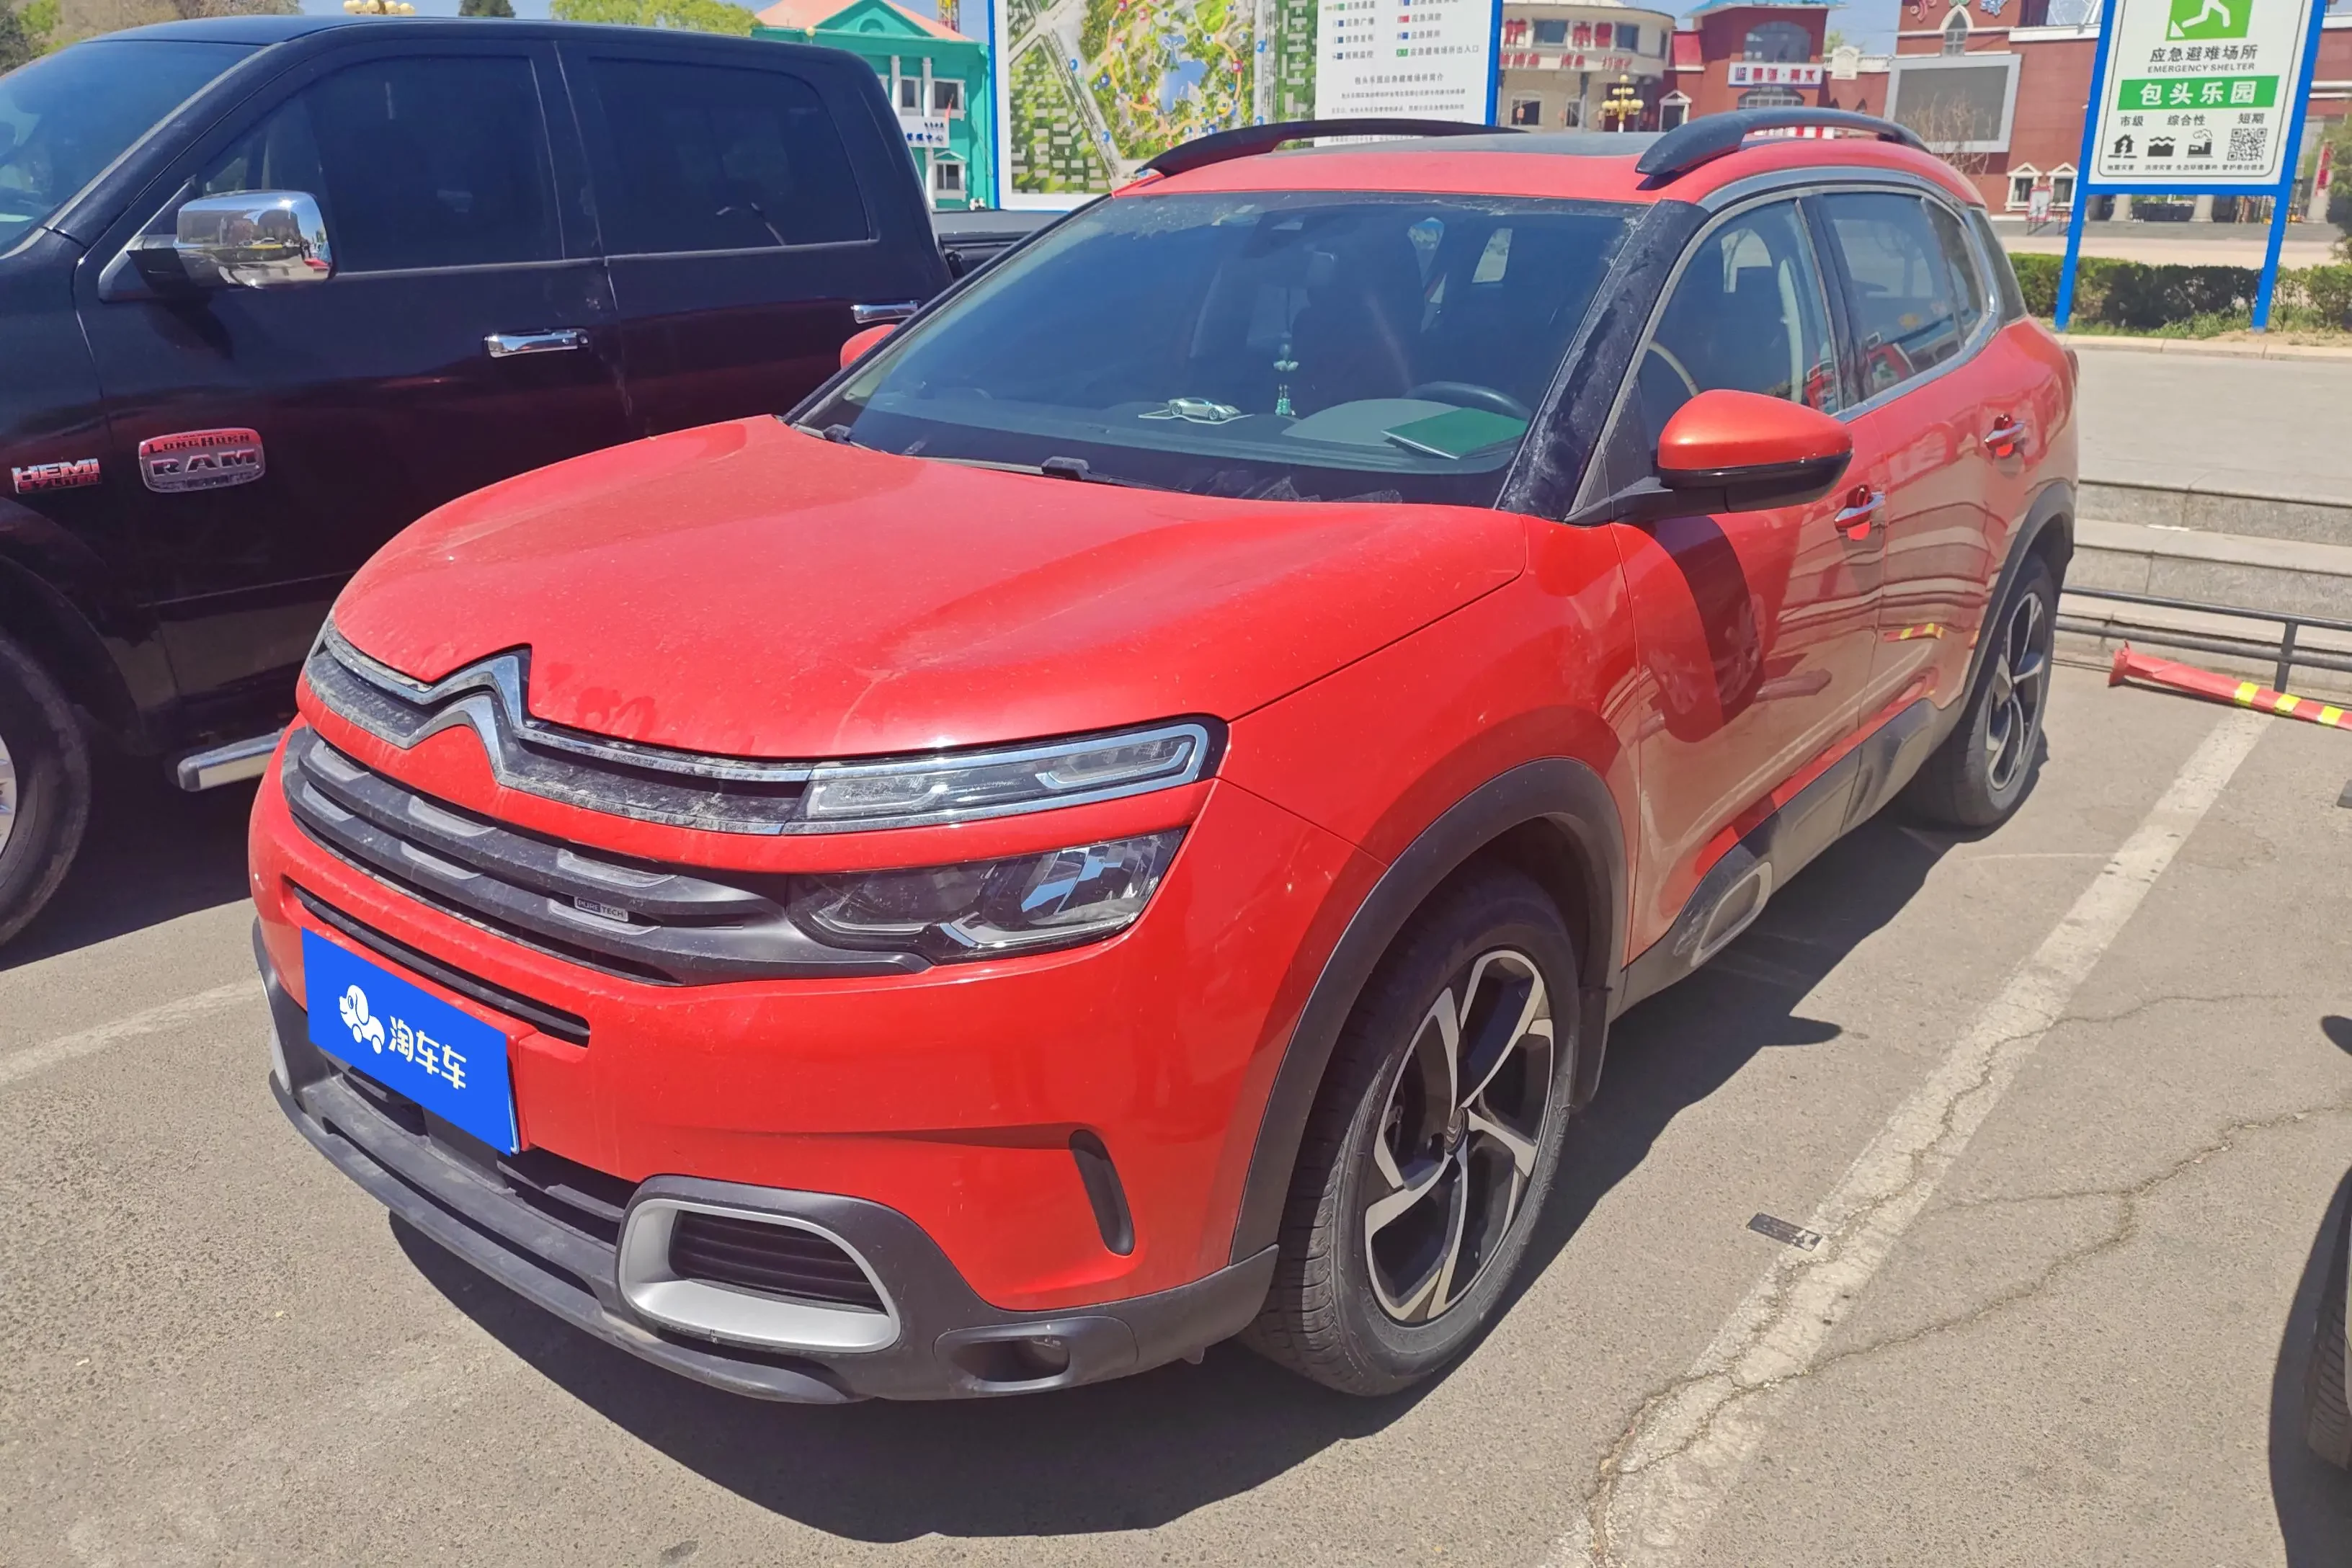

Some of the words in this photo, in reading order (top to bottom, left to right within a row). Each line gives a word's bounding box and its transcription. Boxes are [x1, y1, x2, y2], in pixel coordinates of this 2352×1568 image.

[2150, 44, 2258, 63] 应急避难场所
[2147, 64, 2208, 74] EMERGENCY
[2210, 62, 2255, 71] SHELTER
[2139, 80, 2257, 106] 包头乐园
[2120, 115, 2144, 127] 市级
[2167, 114, 2206, 127] 综合性
[2237, 112, 2266, 125] 短期
[11, 458, 100, 482] HEMI
[150, 448, 257, 477] RAM
[577, 900, 600, 912] PURE
[601, 905, 624, 918] TECH
